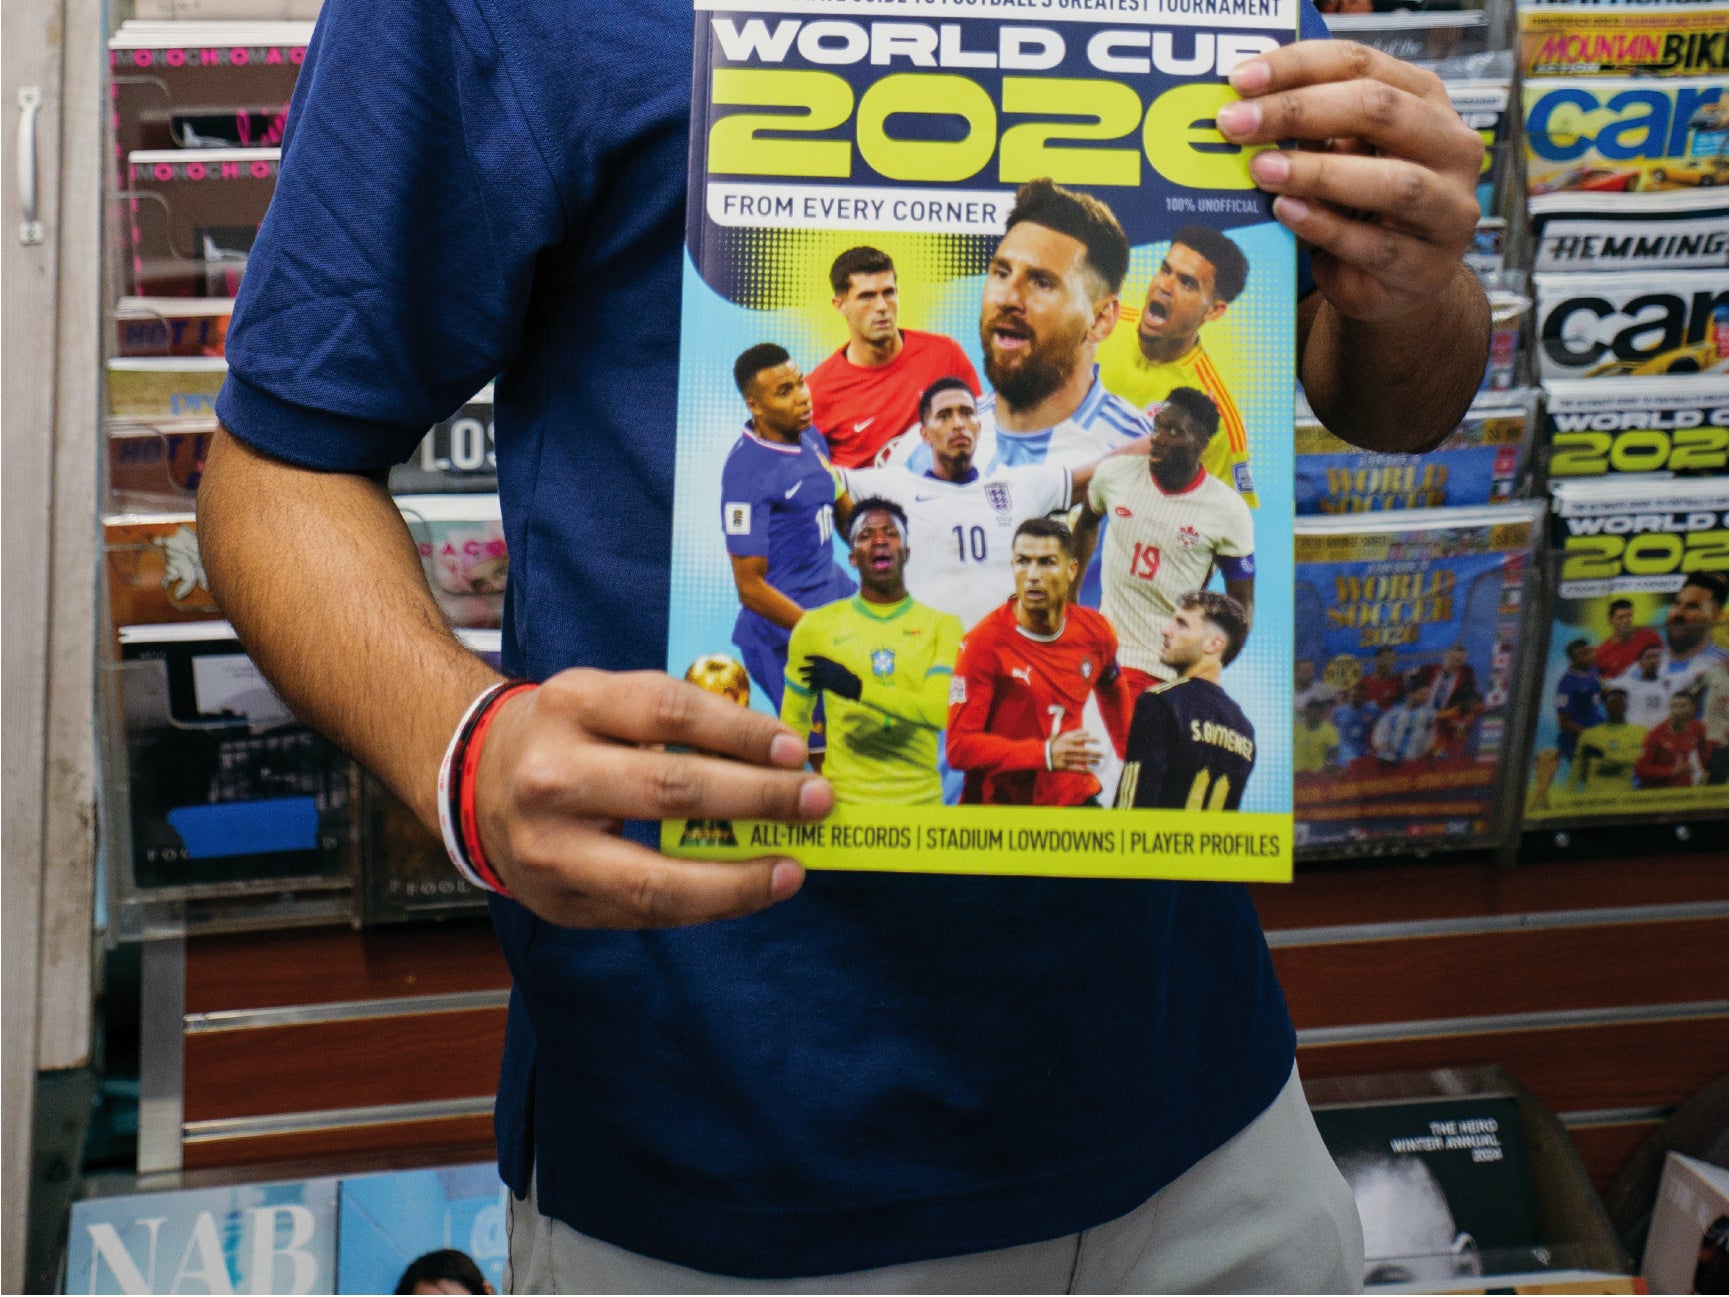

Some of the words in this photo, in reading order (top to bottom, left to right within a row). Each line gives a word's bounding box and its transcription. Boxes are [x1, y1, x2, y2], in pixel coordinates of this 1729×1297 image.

[711, 17, 1067, 70] WORLD
[1086, 29, 1282, 77] CUP
[1534, 32, 1664, 63] MOUNTAIN
[1661, 32, 1729, 70] BIK
[707, 68, 1281, 191] 2026
[1524, 87, 1726, 164] car
[723, 194, 794, 218] FROM
[802, 197, 885, 220] EVERY
[892, 199, 997, 225] CORNER
[1165, 197, 1196, 213] 100%
[1198, 198, 1259, 214] UNOFFICIAL
[1551, 231, 1727, 261] HEMMING
[1542, 290, 1729, 368] car
[1554, 408, 1706, 433] WORLD
[1549, 426, 1729, 477] 202
[1567, 512, 1718, 536] WORLD
[952, 524, 988, 564] 10
[1129, 541, 1161, 582] 19
[1561, 529, 1729, 580] 202
[1047, 704, 1066, 737] 7
[750, 823, 826, 848] ALL-TIME
[831, 825, 911, 849] RECORDS
[926, 827, 1003, 851] STADIUM
[1008, 829, 1115, 853] LOWDOWNS
[1130, 831, 1194, 855] PLAYER
[1200, 832, 1280, 857] PROFILES
[1390, 1136, 1444, 1153] WINTER
[1445, 1133, 1500, 1151] ANNUAL
[1429, 1121, 1458, 1137] THE
[1459, 1118, 1499, 1135] HERO
[86, 1205, 316, 1295] NAB
